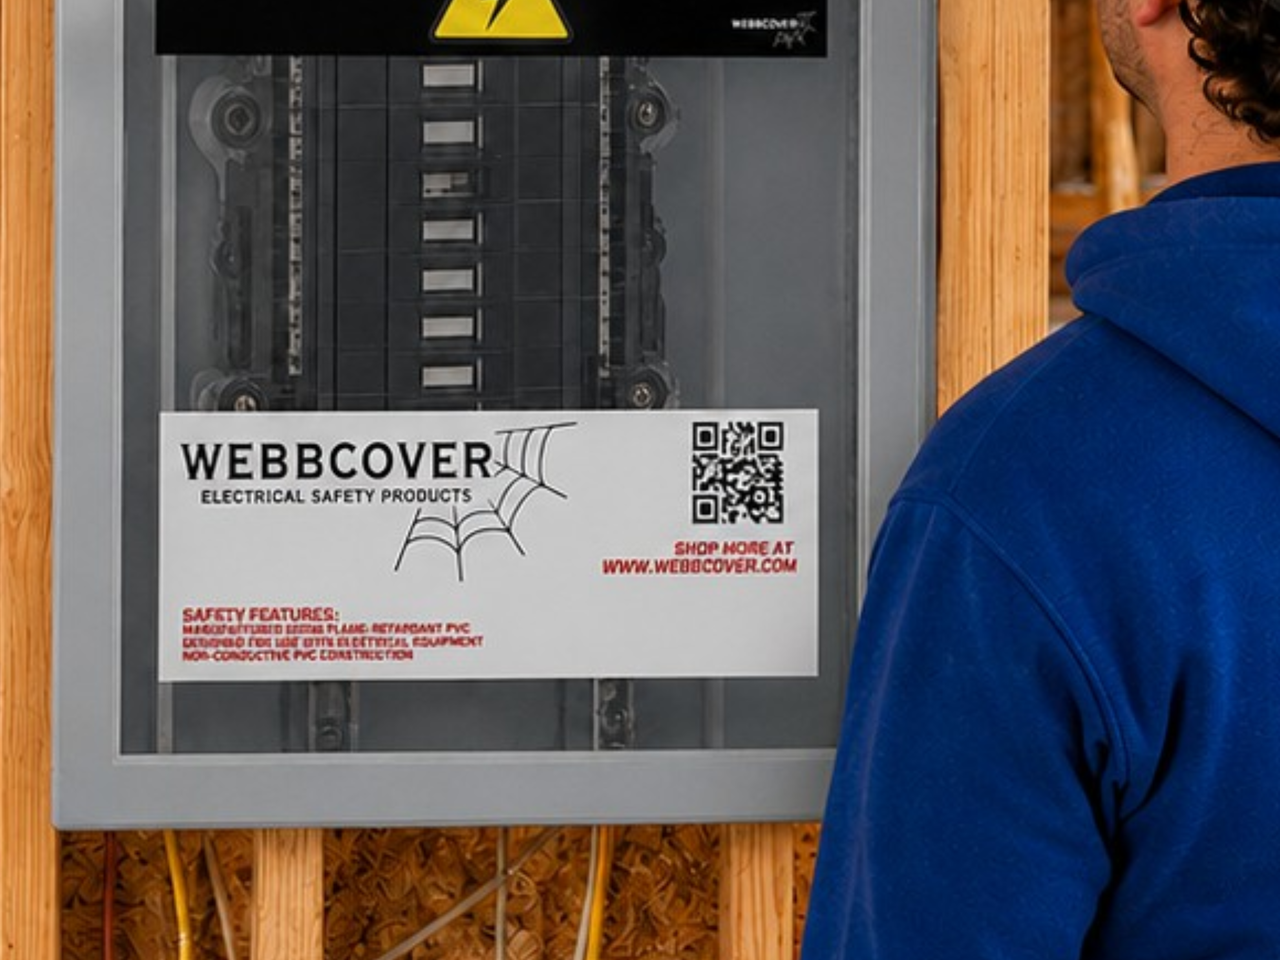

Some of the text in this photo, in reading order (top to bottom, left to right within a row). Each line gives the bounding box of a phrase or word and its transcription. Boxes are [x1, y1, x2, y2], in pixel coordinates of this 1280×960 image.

[181, 442, 491, 480] WEBBCOVER
[201, 488, 471, 504] ELECTRICAL SAFETY PRODUCTS
[675, 541, 794, 556] SHOP MORE AT
[183, 607, 338, 622] SAFETY FEATURES:
